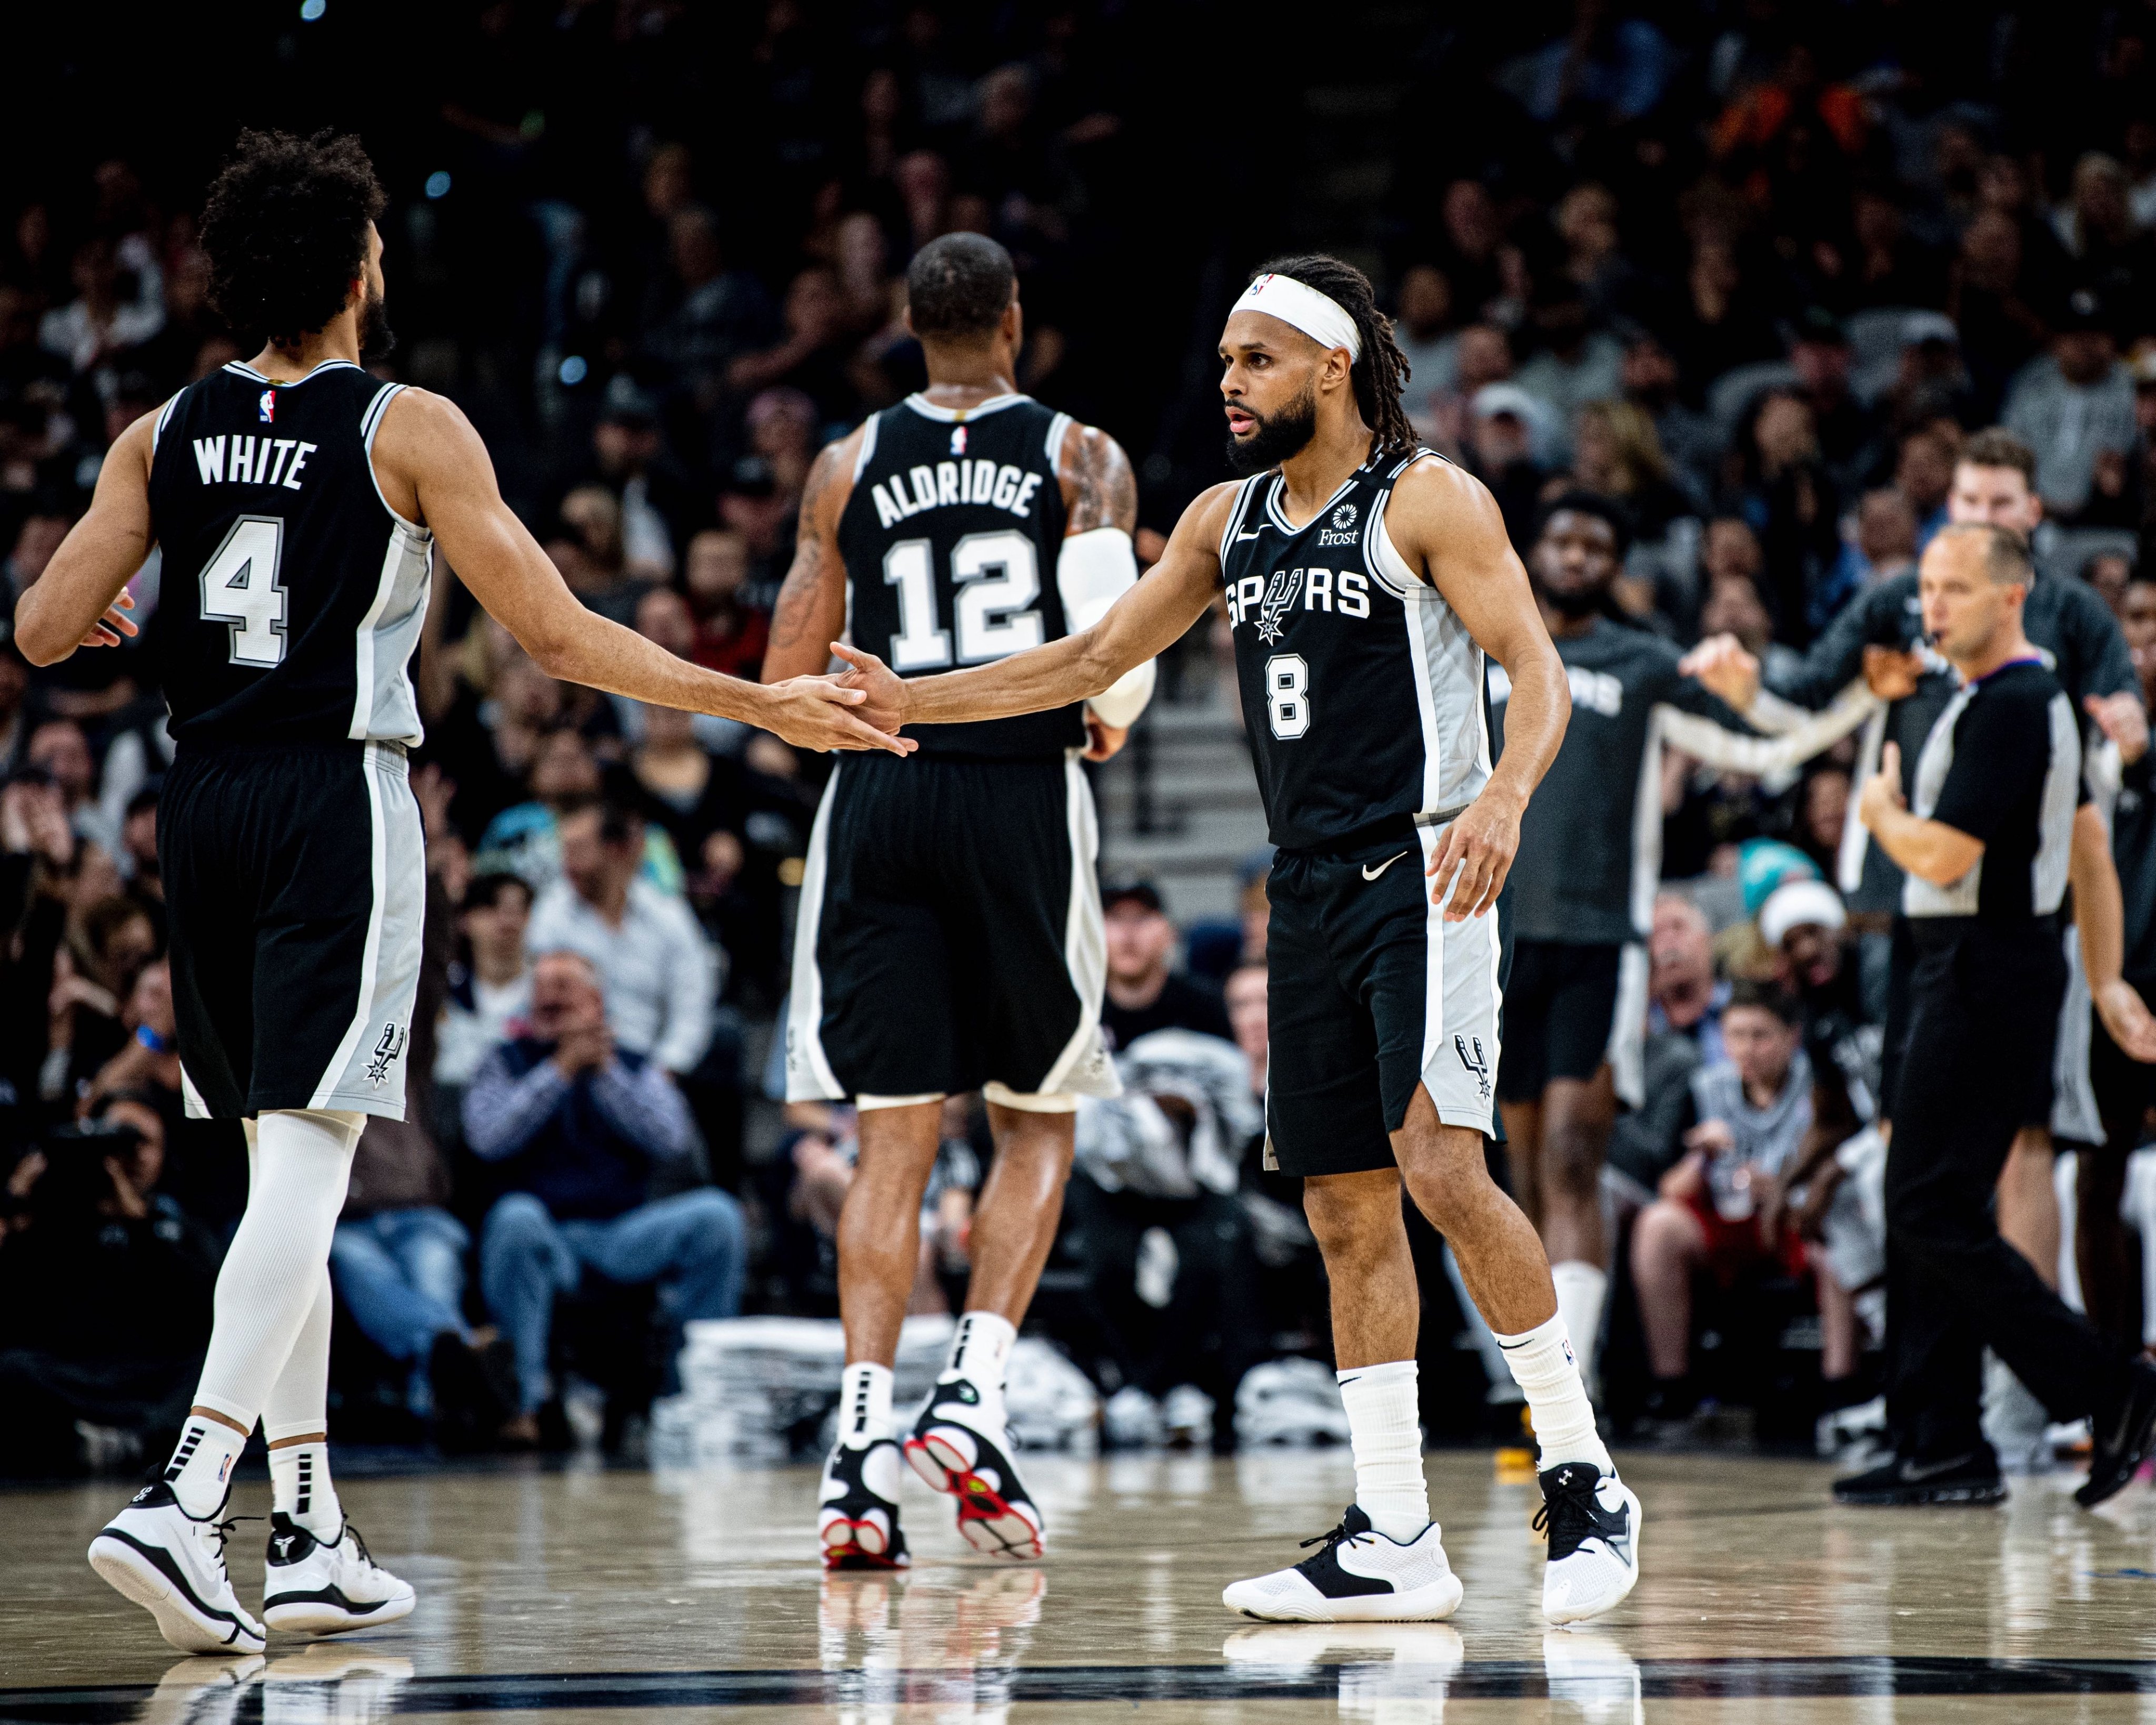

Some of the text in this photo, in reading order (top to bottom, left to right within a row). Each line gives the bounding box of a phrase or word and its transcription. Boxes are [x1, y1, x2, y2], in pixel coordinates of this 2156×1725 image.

[193, 434, 317, 490] WHITE
[871, 458, 1043, 529] ALDRIDGE
[1317, 529, 1359, 546] Frost
[198, 514, 288, 669] 4
[882, 529, 1045, 673] 12
[1225, 568, 1370, 646] SPURS
[1264, 653, 1311, 741] 8
